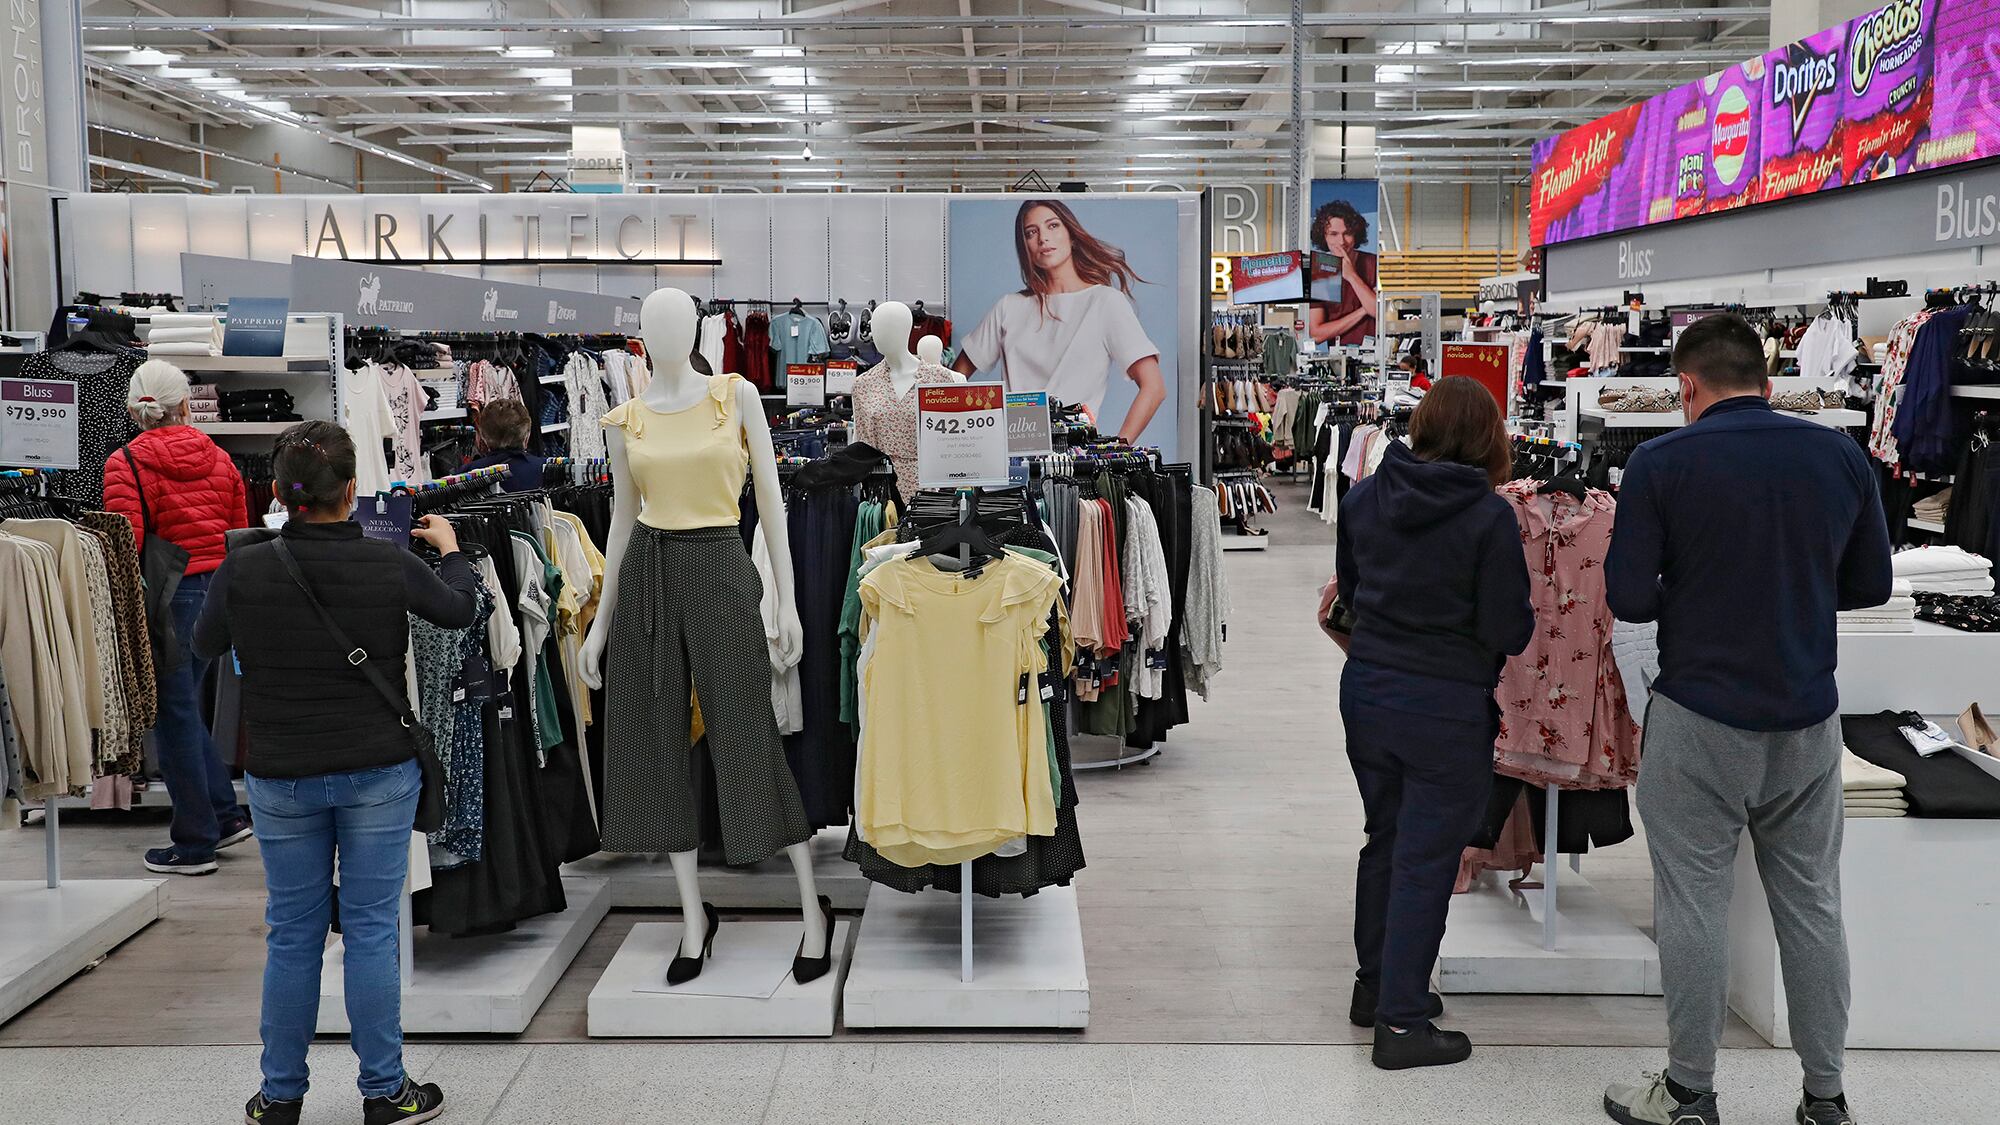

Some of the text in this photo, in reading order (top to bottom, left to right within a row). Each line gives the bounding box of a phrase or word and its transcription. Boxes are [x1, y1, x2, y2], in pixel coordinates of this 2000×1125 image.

[1852, 0, 1922, 92] Cheetos
[1879, 35, 1923, 73] HORNEADOS
[26, 0, 42, 125] ACTIV
[1774, 53, 1837, 102] Doritos
[1889, 76, 1918, 104] CRUNCHY
[1713, 119, 1750, 149] Margarita
[1890, 119, 1911, 145] Hot
[1585, 128, 1616, 171] Hot
[1810, 154, 1841, 184] Hot
[1936, 182, 2000, 241] Blus
[315, 204, 697, 259] ARKITECT
[1619, 240, 1652, 279] Bluss
[377, 300, 414, 314] PATPRIMO
[23, 384, 53, 398] Bluss
[190, 386, 203, 394] UP
[925, 389, 945, 398] ¡Feliz
[925, 396, 959, 404] navidad!
[6, 405, 67, 421] $79.990
[197, 402, 210, 410] UP
[926, 416, 995, 434] $42.900
